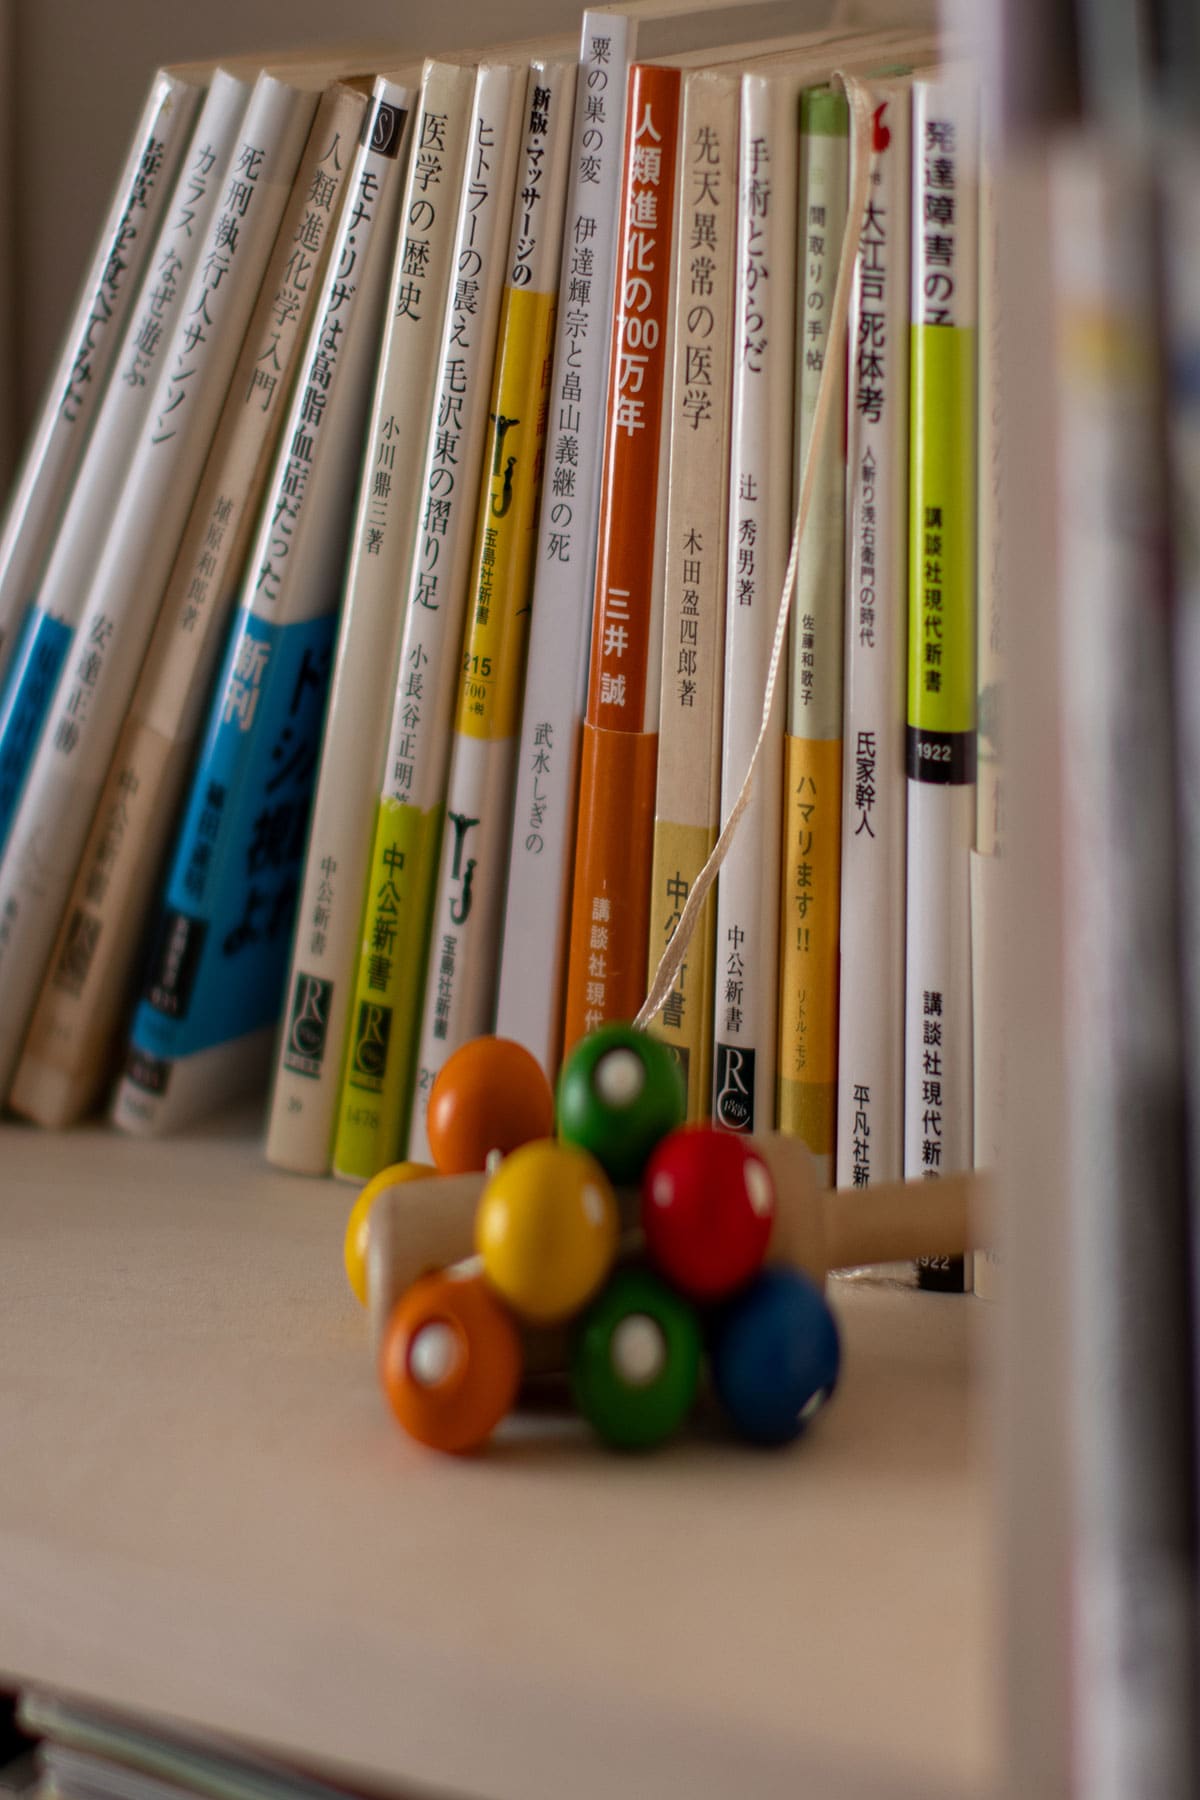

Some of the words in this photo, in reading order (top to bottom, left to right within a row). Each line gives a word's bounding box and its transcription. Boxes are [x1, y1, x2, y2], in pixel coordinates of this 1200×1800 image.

[151, 144, 265, 445] 死刑執行人サンソン
[246, 132, 343, 412] 人類進化学入門
[395, 112, 449, 323] 医学の歴史
[682, 126, 721, 431] 先天異常の医学
[744, 137, 773, 373] 手術とからだ
[806, 205, 827, 372] 間取りの手帖
[256, 172, 379, 601] モナ・リザは高脂血症だった
[365, 415, 400, 556] 小川鼎三著
[463, 651, 492, 677] 215
[676, 527, 703, 708] 木田盈四郎著
[800, 613, 815, 707] 佐藤和歌子
[923, 506, 944, 693] 講談社現代新書
[224, 633, 271, 732] 新刊
[917, 743, 952, 762] 1922
[524, 722, 554, 855] 武水しぎの
[854, 731, 876, 839] 氏家幹人
[309, 855, 337, 957] 中公新書
[366, 841, 406, 993] 中公新書
[724, 924, 745, 1033] 中公新書
[922, 990, 943, 1178] 講談社現代新
